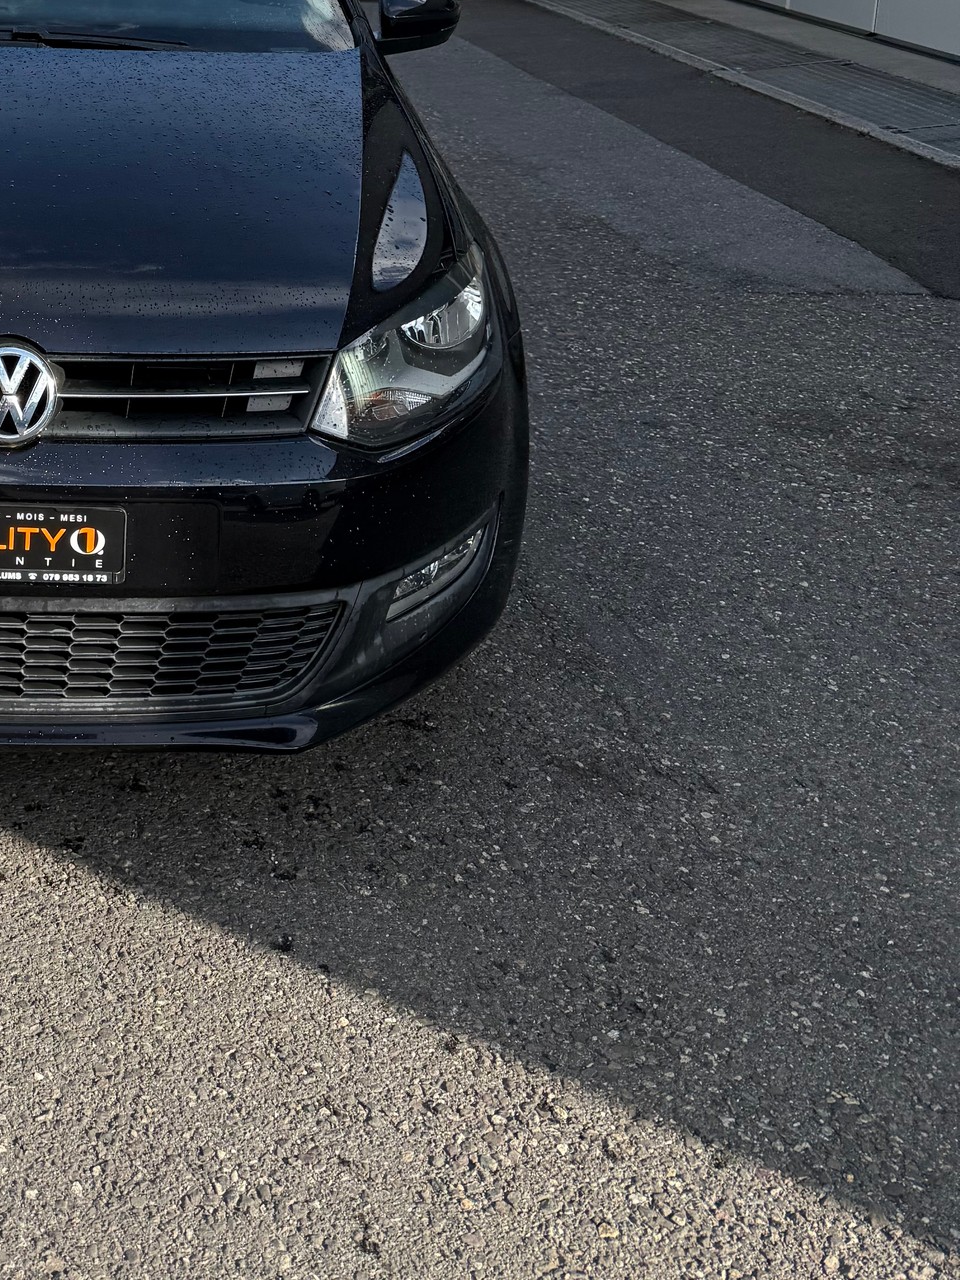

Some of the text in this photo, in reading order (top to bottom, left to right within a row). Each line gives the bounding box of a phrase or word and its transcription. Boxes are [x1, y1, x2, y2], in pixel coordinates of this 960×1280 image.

[16, 513, 45, 521] MOIS
[60, 514, 87, 523] MESI
[95, 574, 108, 583] 73
